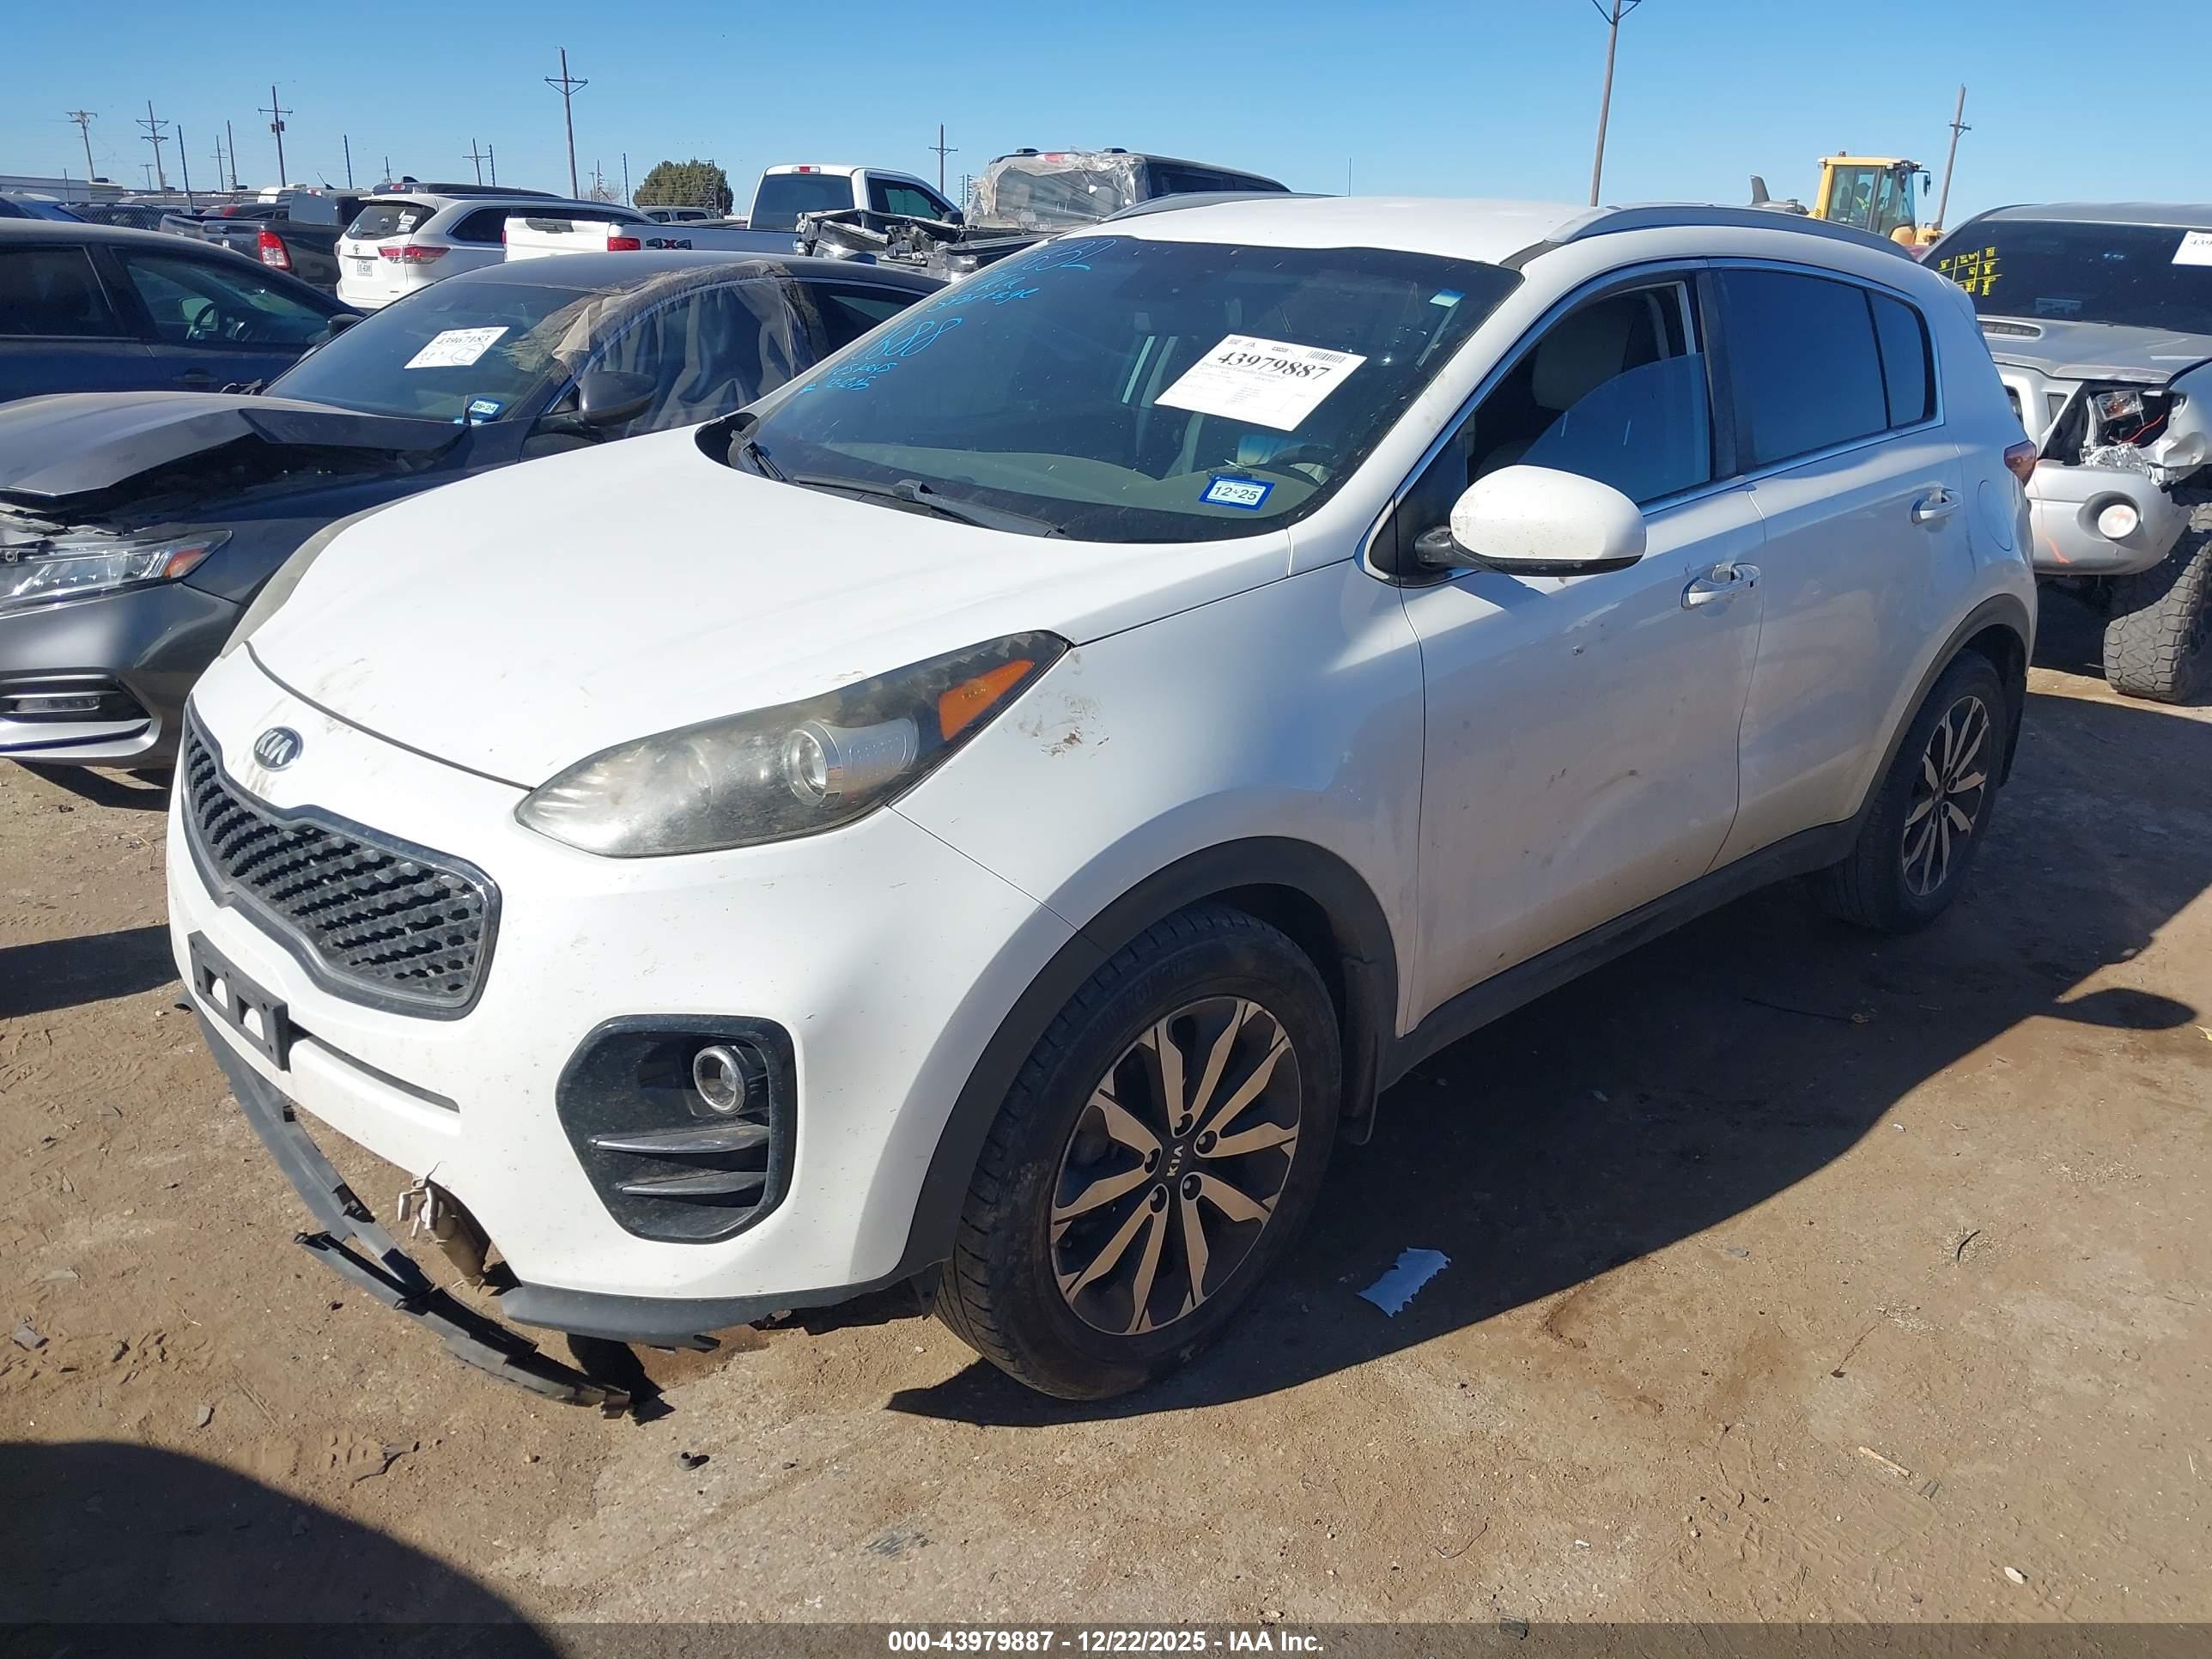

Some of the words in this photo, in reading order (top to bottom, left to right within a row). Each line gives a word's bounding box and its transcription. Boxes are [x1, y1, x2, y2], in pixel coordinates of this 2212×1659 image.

[1217, 351, 1333, 380] 43979887
[255, 729, 294, 765] KIA
[1166, 1146, 1184, 1176] KIA
